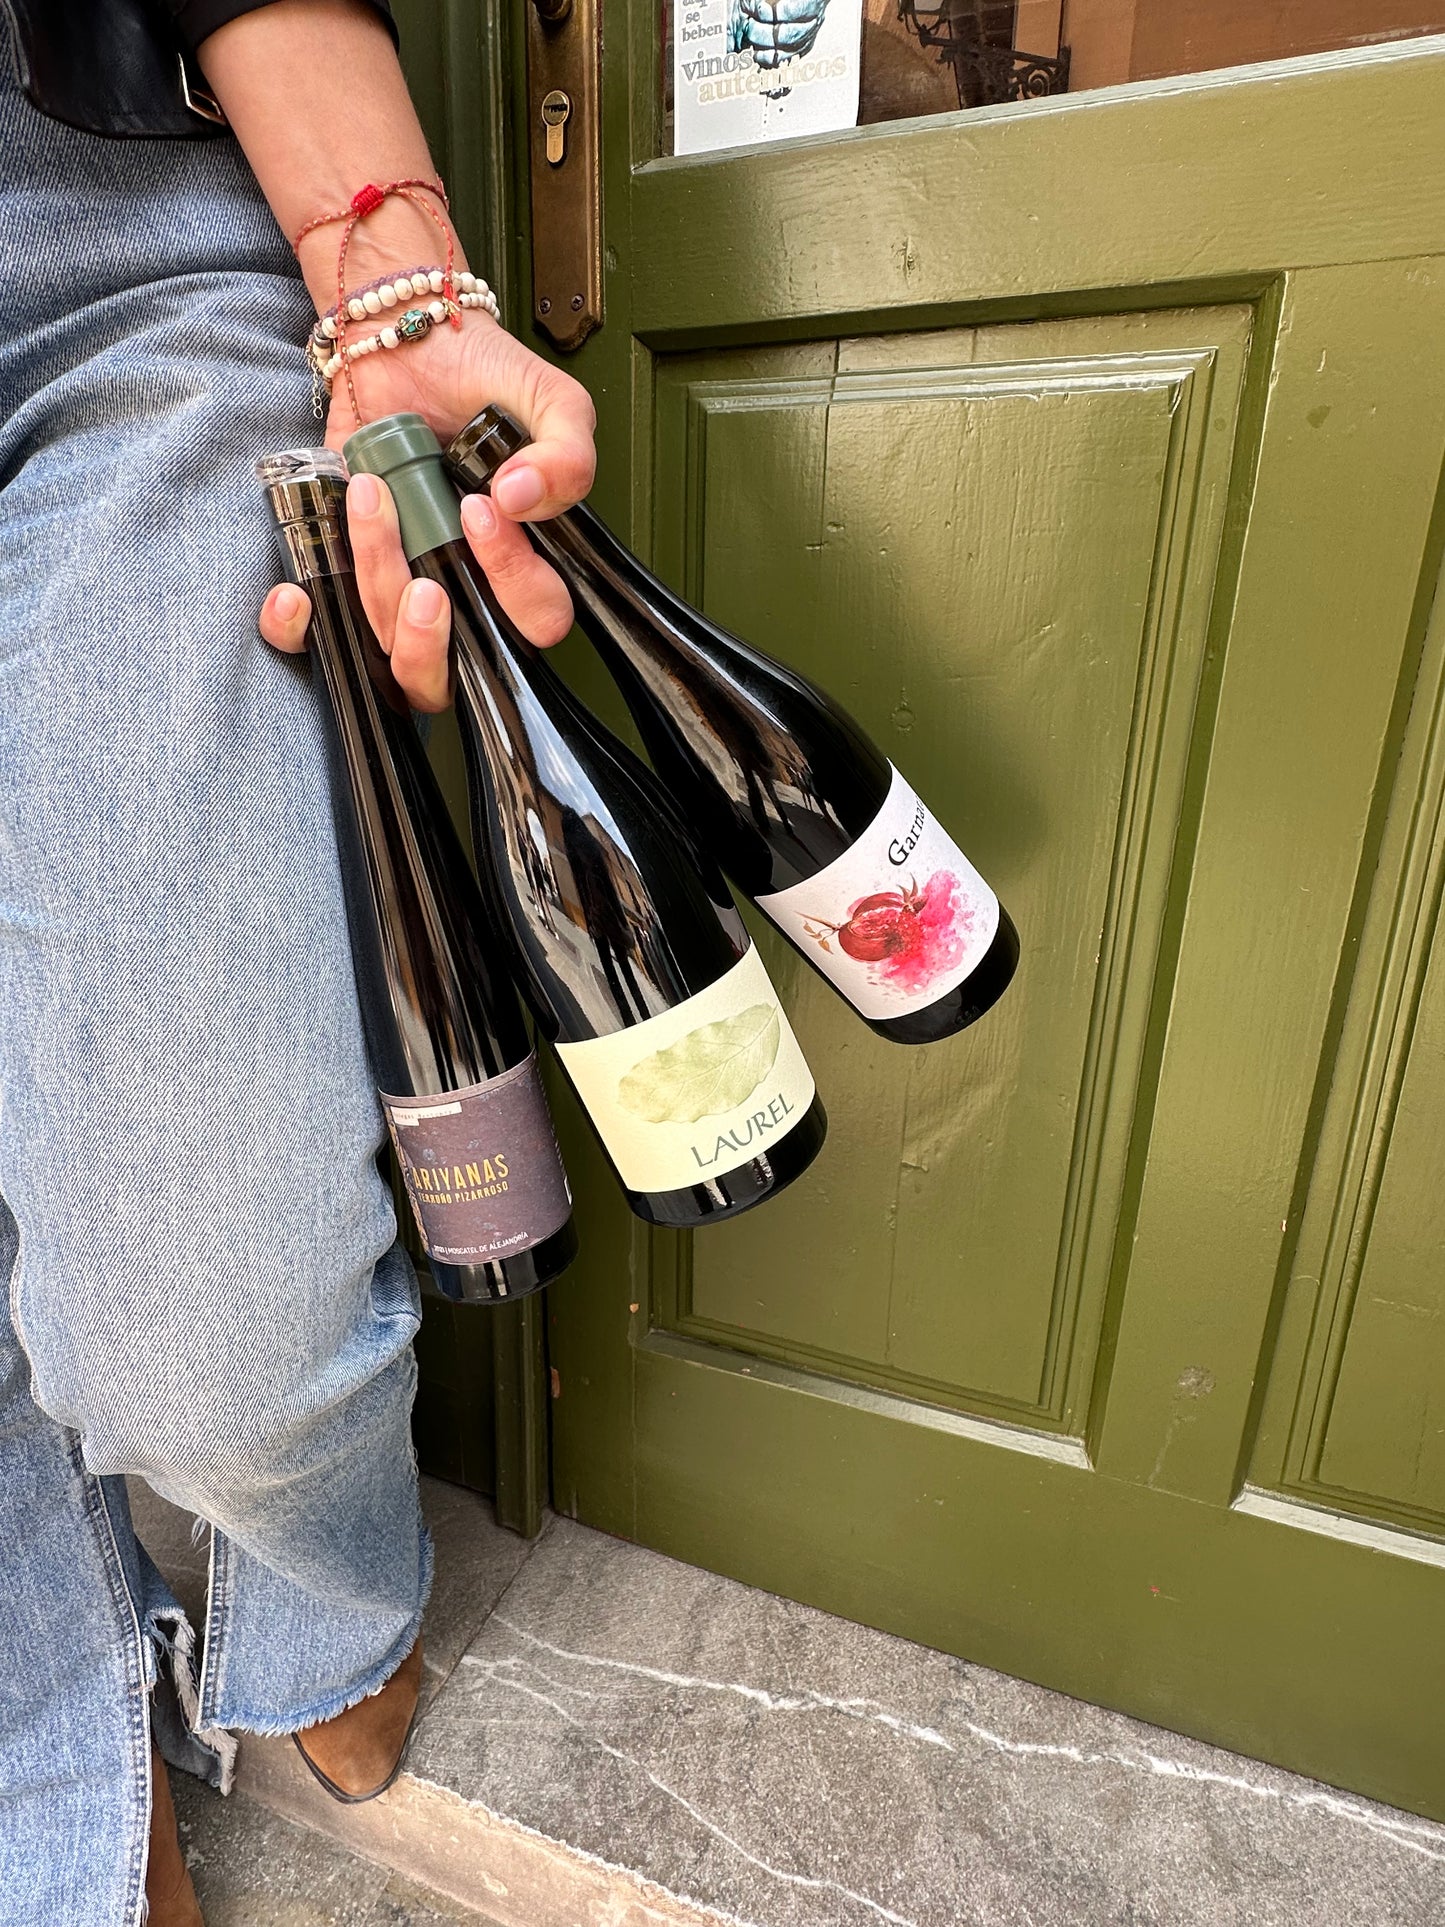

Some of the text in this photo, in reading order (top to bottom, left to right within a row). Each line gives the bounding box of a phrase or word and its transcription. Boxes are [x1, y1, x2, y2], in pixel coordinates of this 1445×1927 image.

[685, 11, 701, 24] se
[681, 23, 723, 43] beben
[681, 50, 754, 81] vinos
[699, 55, 847, 103] auténticos
[690, 1093, 795, 1168] LAUREL
[412, 1153, 509, 1191] ARIYANAS
[454, 1180, 509, 1203] PIZARROSO
[447, 1246, 479, 1255] MOSCATEL
[478, 1244, 489, 1253] DE
